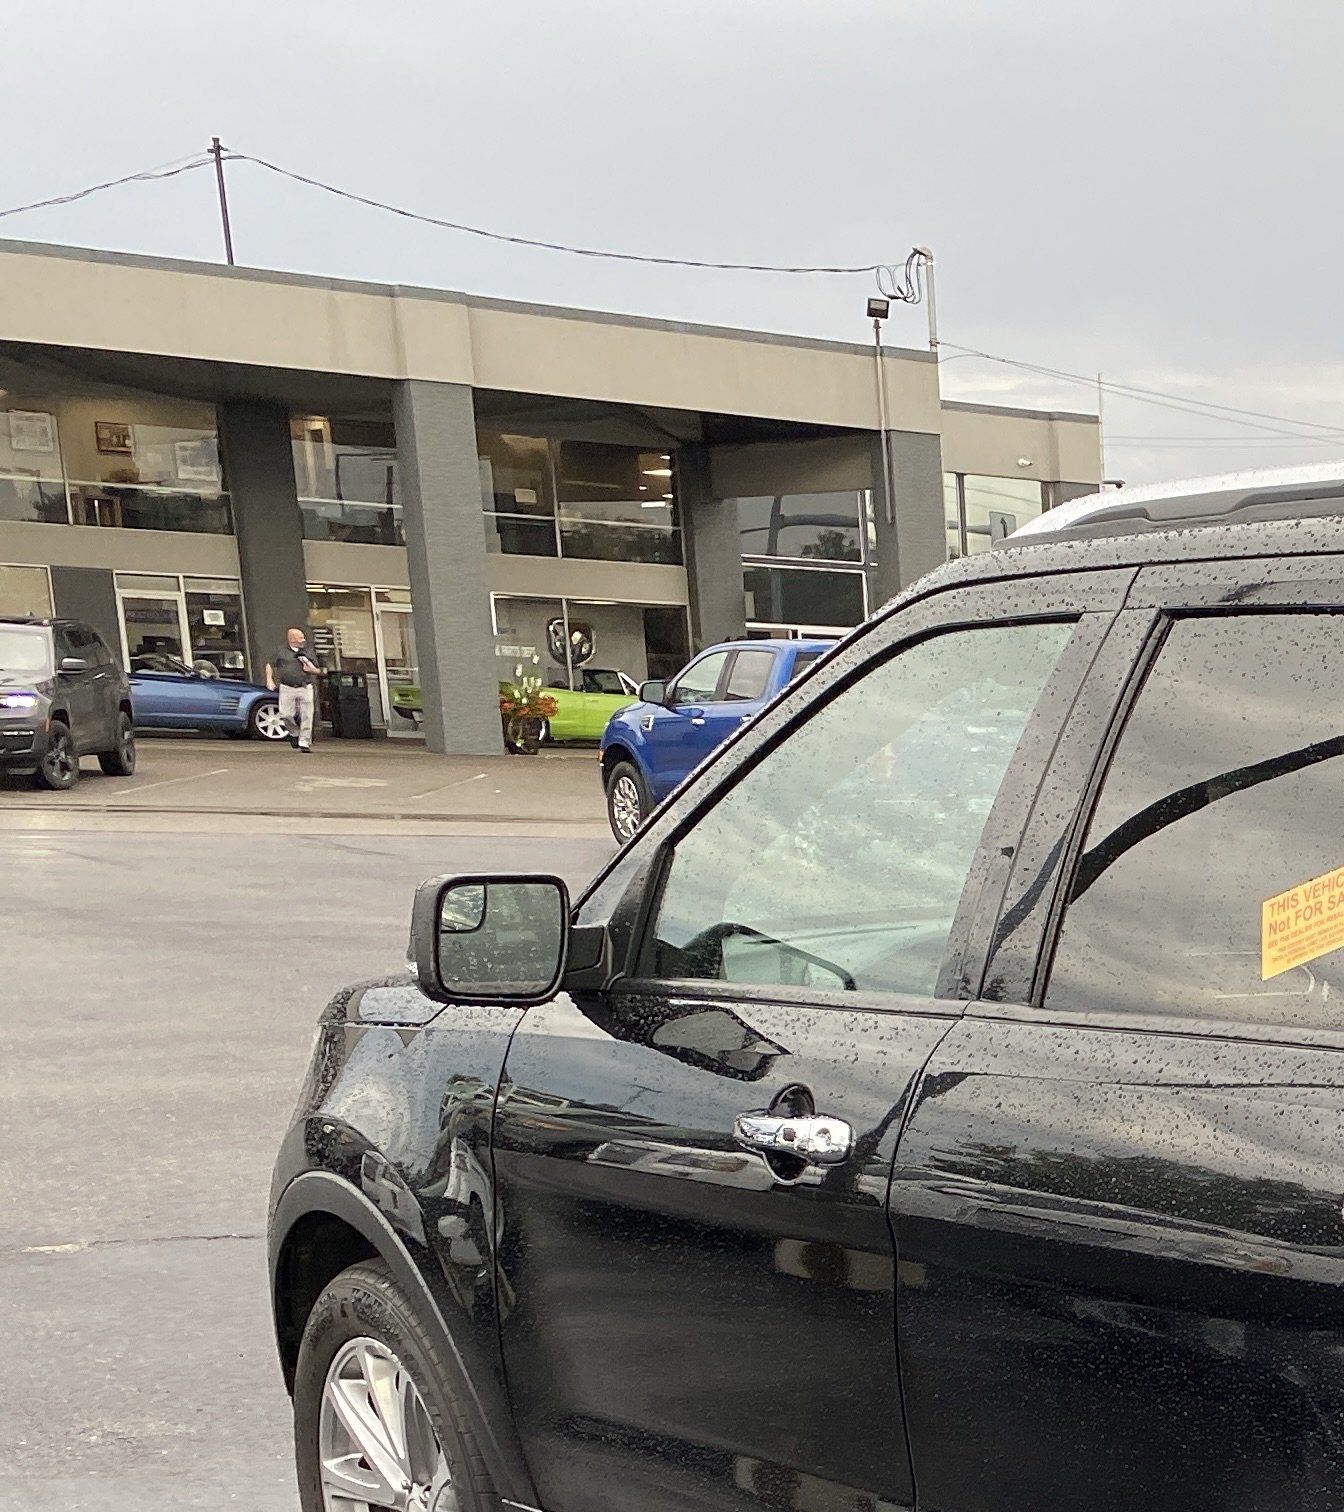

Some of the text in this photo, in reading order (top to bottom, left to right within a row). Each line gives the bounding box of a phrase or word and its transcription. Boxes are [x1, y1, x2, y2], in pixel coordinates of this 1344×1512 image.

[1268, 917, 1291, 938] Not
[1294, 900, 1323, 926] FOR
[1269, 893, 1299, 918] THIS
